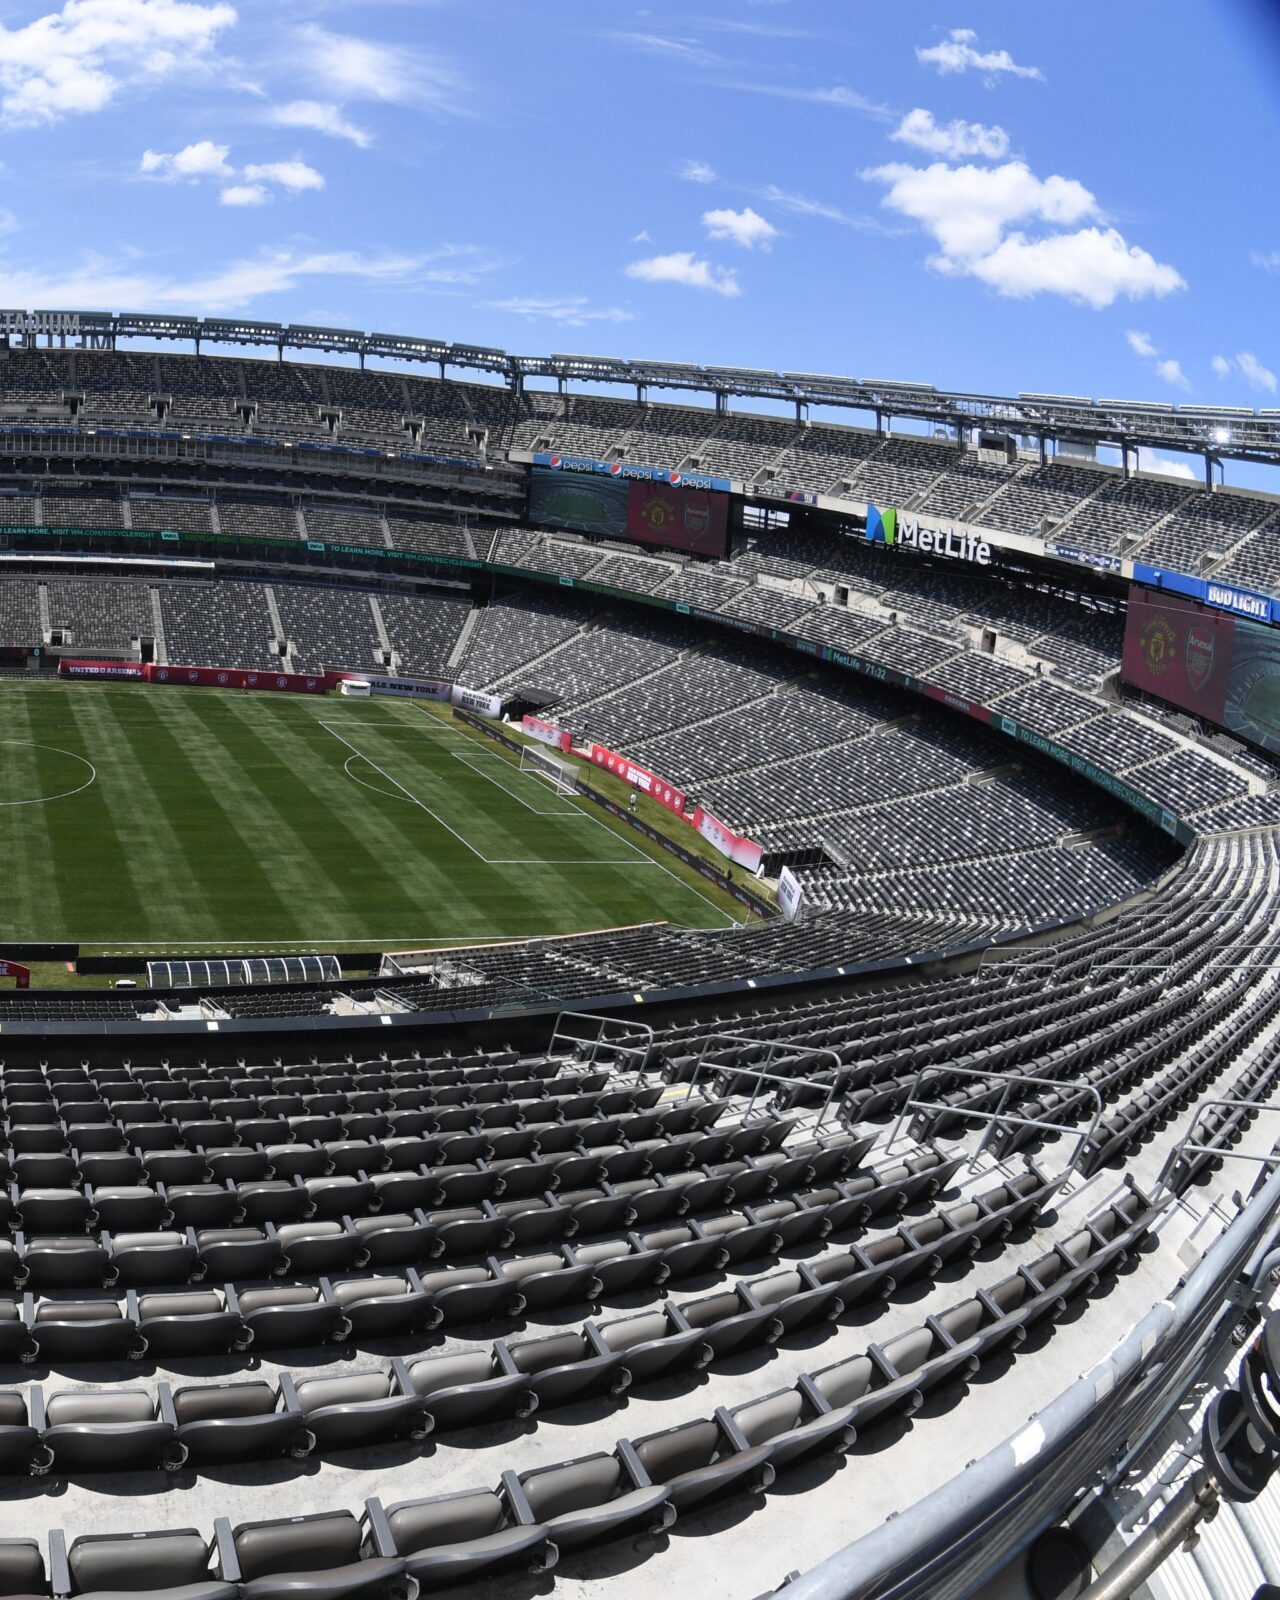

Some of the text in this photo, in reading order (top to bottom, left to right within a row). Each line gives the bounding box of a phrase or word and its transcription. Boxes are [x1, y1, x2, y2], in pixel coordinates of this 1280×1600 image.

[563, 460, 593, 472] pepsi
[623, 467, 652, 480] pepsi
[681, 476, 711, 489] pepsi
[897, 517, 991, 565] MetLife
[1208, 585, 1268, 617] BUD LIGHT
[34, 648, 40, 656] 0
[833, 652, 861, 669] MetLife
[69, 666, 142, 676] UNITED ARSENAL
[865, 663, 887, 680] 71:32
[389, 683, 413, 692] NEW
[1029, 733, 1050, 750] LEARN
